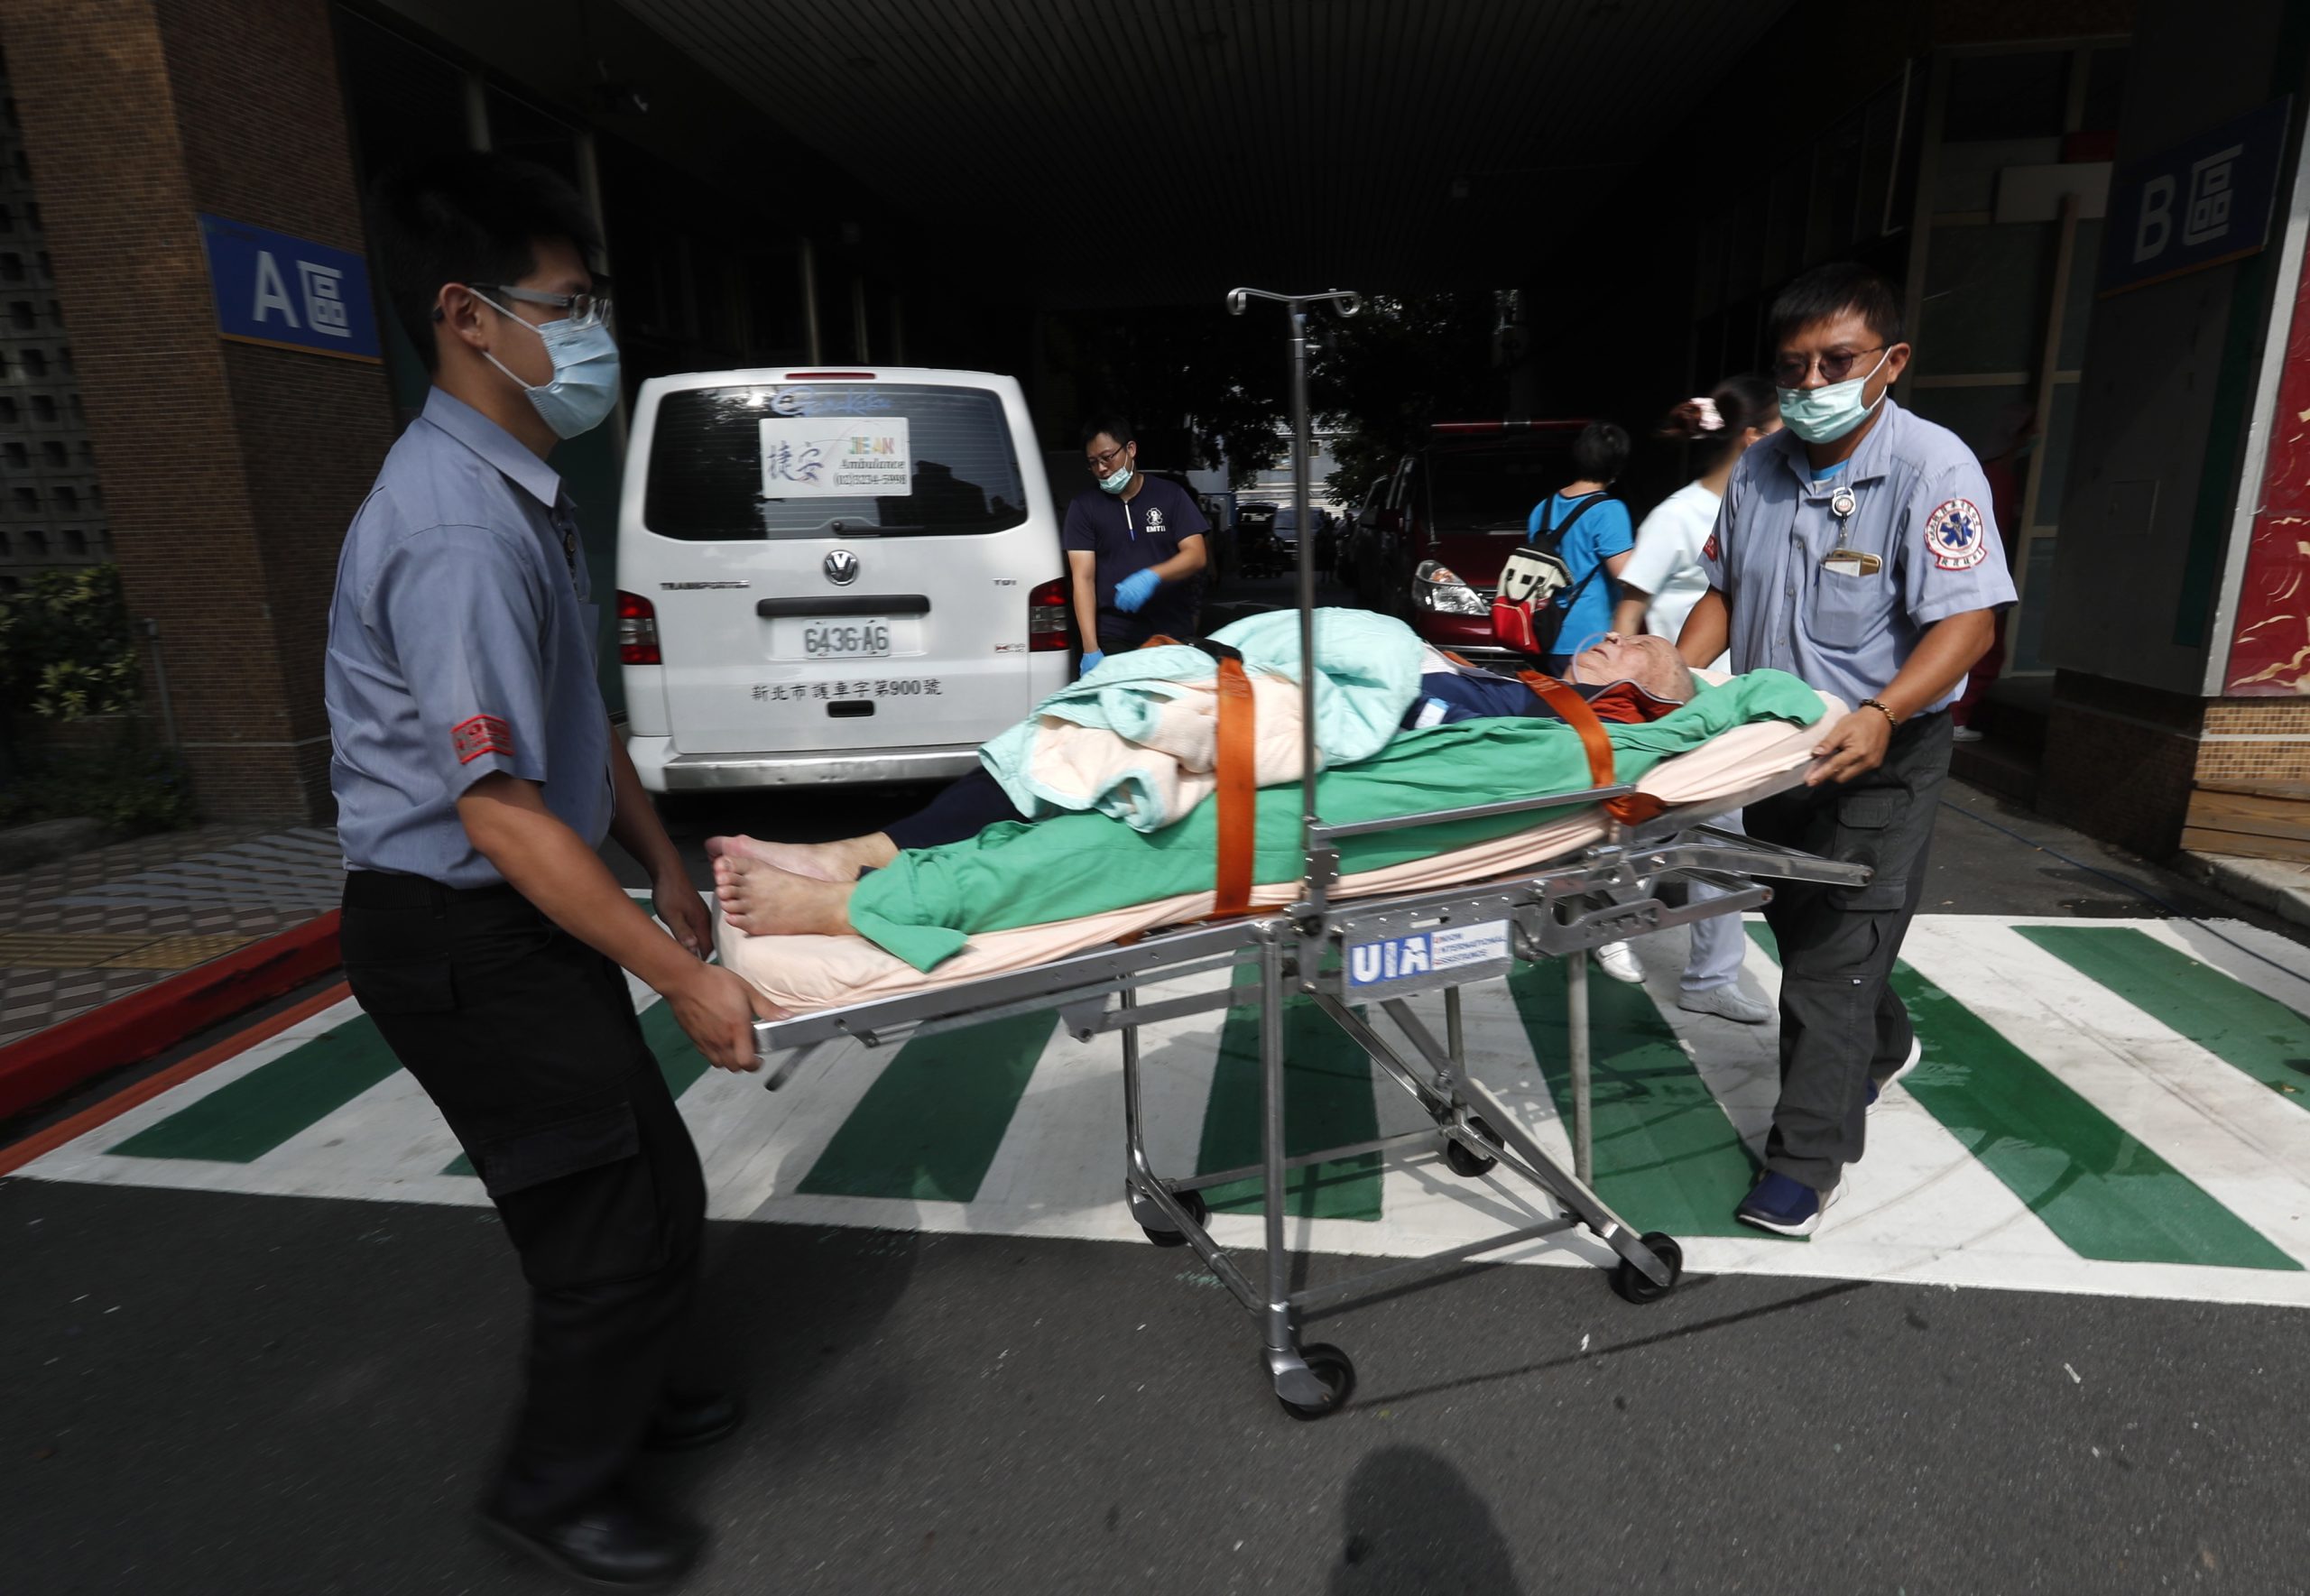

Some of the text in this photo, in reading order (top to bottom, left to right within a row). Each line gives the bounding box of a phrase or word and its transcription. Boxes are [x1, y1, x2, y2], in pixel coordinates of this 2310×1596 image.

[2133, 143, 2244, 264] B區
[253, 250, 352, 337] A區
[839, 457, 905, 469] Ambulance
[1353, 936, 1430, 983] UIA
